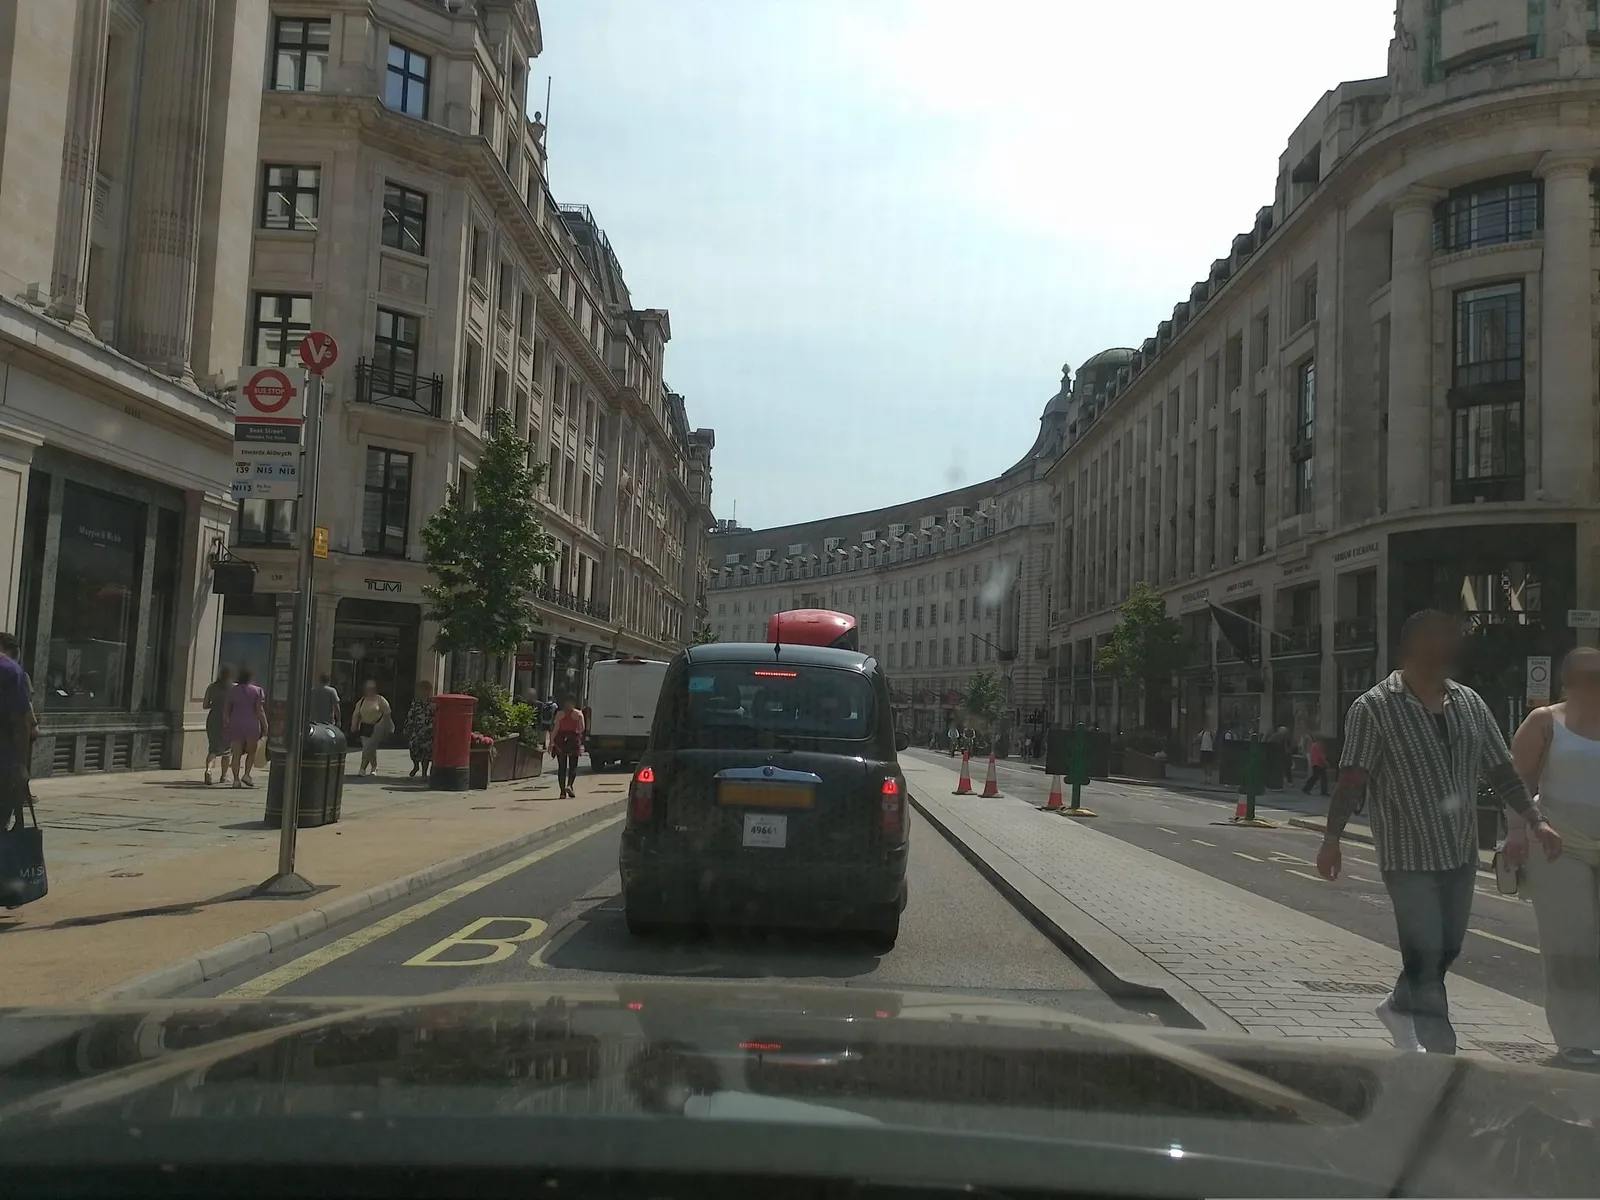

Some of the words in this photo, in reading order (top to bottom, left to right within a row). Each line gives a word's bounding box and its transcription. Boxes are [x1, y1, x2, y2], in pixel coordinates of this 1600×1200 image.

[267, 387, 286, 395] STOP
[266, 449, 292, 457] Aldwych
[236, 466, 250, 474] 139
[256, 466, 273, 474] N15
[279, 467, 296, 475] N18
[232, 484, 252, 492] N113
[364, 578, 402, 593] TUMI
[750, 826, 777, 836] 49661
